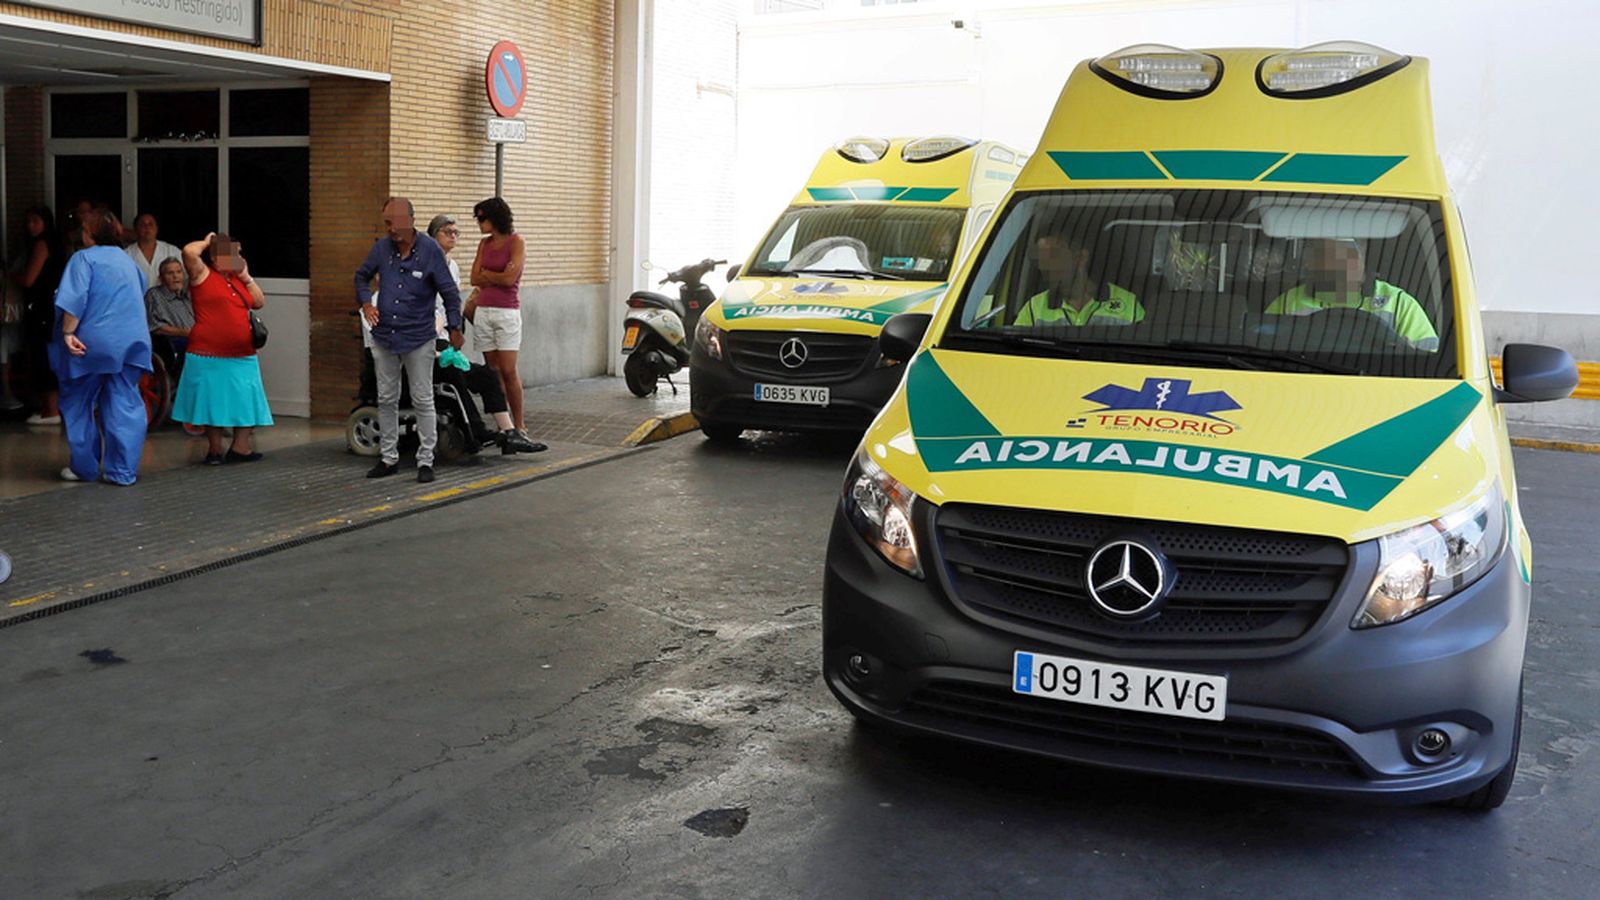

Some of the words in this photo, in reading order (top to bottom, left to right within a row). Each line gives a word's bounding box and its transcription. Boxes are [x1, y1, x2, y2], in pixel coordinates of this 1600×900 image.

[764, 387, 796, 401] 0635
[801, 389, 826, 402] KVG
[1098, 415, 1233, 435] TENORIO
[1146, 428, 1217, 438] EMPRESARIAL
[1039, 662, 1129, 702] 0913
[1145, 675, 1215, 713] KVG
